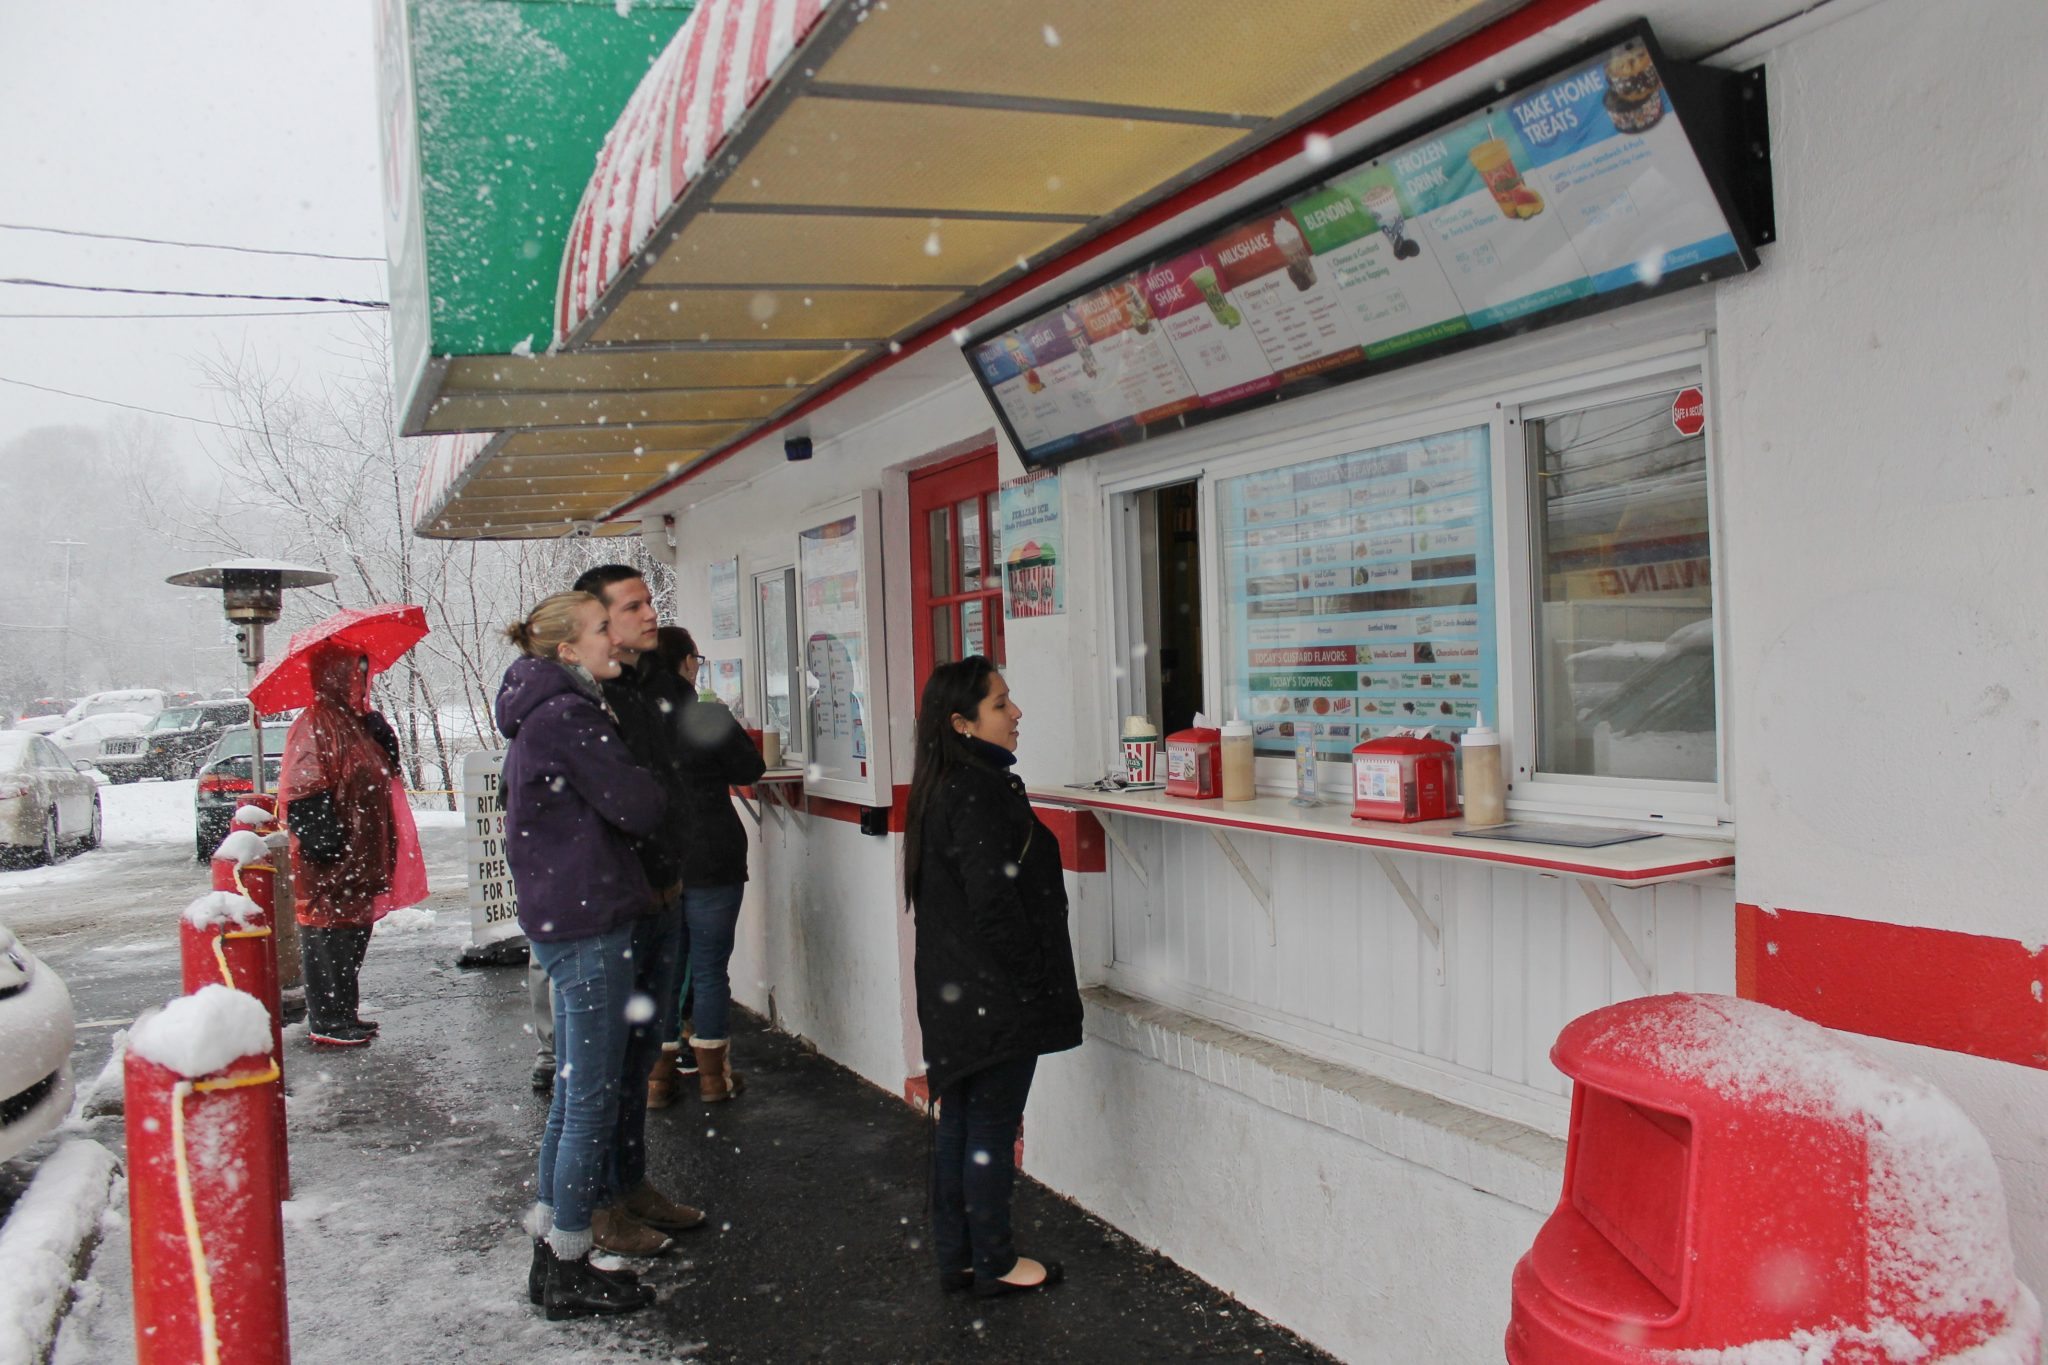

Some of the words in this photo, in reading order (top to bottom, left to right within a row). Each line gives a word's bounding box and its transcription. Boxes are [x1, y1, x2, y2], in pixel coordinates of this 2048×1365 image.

[1514, 95, 1553, 124] TAKE
[1552, 70, 1604, 107] HOME
[1525, 108, 1579, 145] TREATS
[1394, 140, 1448, 176] FROZEN
[1405, 166, 1449, 196] DRINK
[1304, 197, 1356, 230] BLENDINI
[1218, 233, 1271, 266] MILKSHAKE
[1332, 252, 1354, 267] Choose
[1357, 242, 1380, 256] Custard
[1146, 269, 1175, 290] MISTO
[1367, 266, 1390, 280] Topping
[1155, 284, 1185, 306] SHAKE
[1675, 408, 1685, 422] SAFE
[1012, 506, 1037, 521] ITALIAN
[1038, 503, 1049, 514] ICE
[1388, 568, 1399, 576] Fruit
[1384, 623, 1397, 631] Water
[1256, 653, 1281, 664] TODAY'S
[1283, 651, 1313, 662] CUSTARD
[1315, 650, 1347, 662] FLAVORS:
[1373, 650, 1389, 658] Vanilla
[1389, 649, 1407, 658] Custard
[1460, 648, 1478, 657] Custard
[1269, 676, 1297, 688] TODAY'S
[1298, 675, 1333, 687] TOPPINGS:
[1334, 697, 1351, 711] Nilla
[477, 818, 490, 836] TO
[483, 839, 496, 857] TO
[479, 860, 505, 880] FREE
[483, 882, 503, 901] FOR
[507, 880, 517, 896] T
